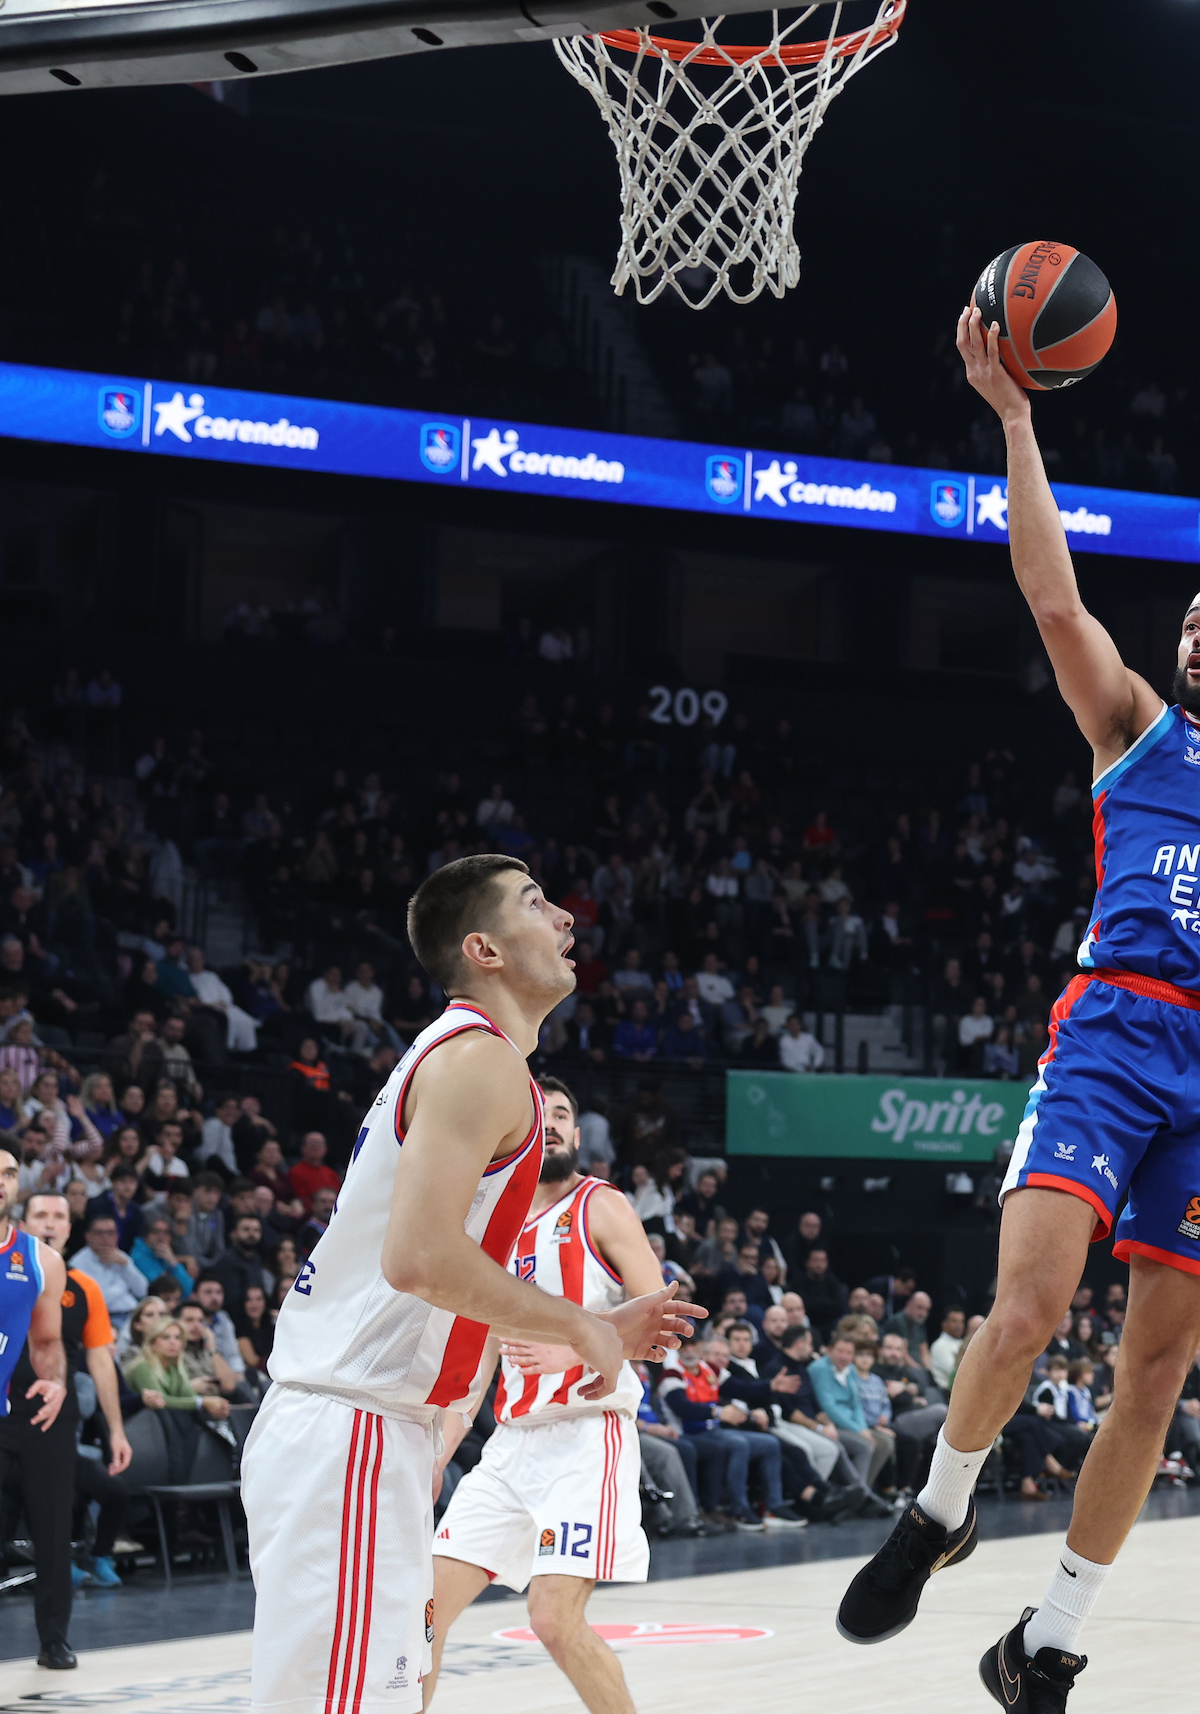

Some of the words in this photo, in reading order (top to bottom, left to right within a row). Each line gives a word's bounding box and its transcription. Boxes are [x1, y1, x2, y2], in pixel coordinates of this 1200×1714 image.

[193, 416, 319, 450] corendon
[509, 447, 624, 484] corendon
[788, 481, 897, 513] corendon
[1060, 506, 1112, 536] ndon
[648, 684, 729, 726] 209
[871, 1088, 1005, 1142] Sprite
[560, 1521, 592, 1559] 12
